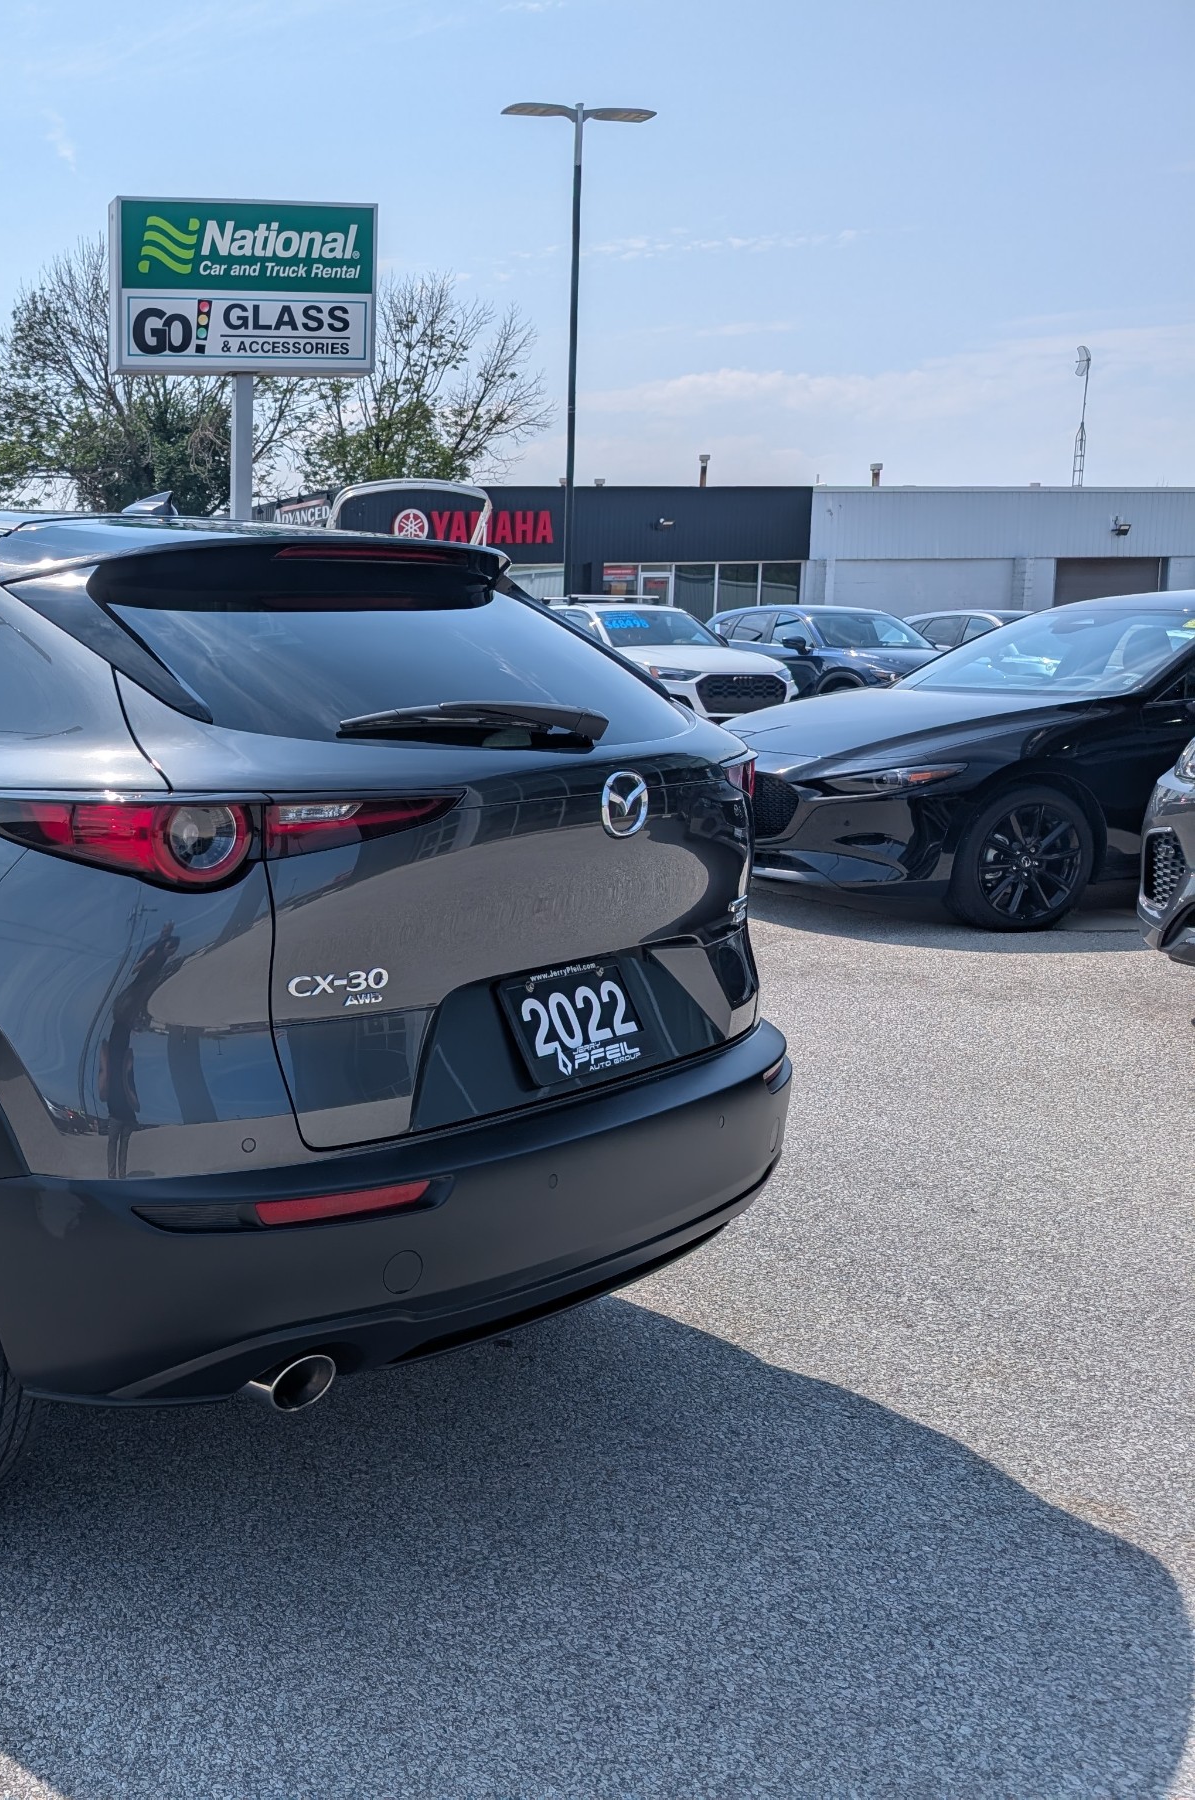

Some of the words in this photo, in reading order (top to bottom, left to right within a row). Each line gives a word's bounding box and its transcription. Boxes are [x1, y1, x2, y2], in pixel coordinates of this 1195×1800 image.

[201, 220, 359, 259] National
[199, 261, 227, 276] Car
[230, 262, 261, 276] and
[265, 263, 307, 278] Truck
[311, 264, 361, 279] Rental
[222, 303, 350, 332] GLASS
[221, 341, 232, 353] &
[236, 341, 350, 355] ACCESSORIES
[288, 967, 389, 997] CX-30
[530, 963, 596, 982] www.JerryPfeil.com
[344, 993, 383, 1006] AWD
[521, 980, 638, 1057] 2022
[573, 1041, 601, 1055] JERRY
[575, 1041, 640, 1069] PFEIL
[589, 1060, 611, 1071] AUTO
[614, 1052, 641, 1064] GROUP
